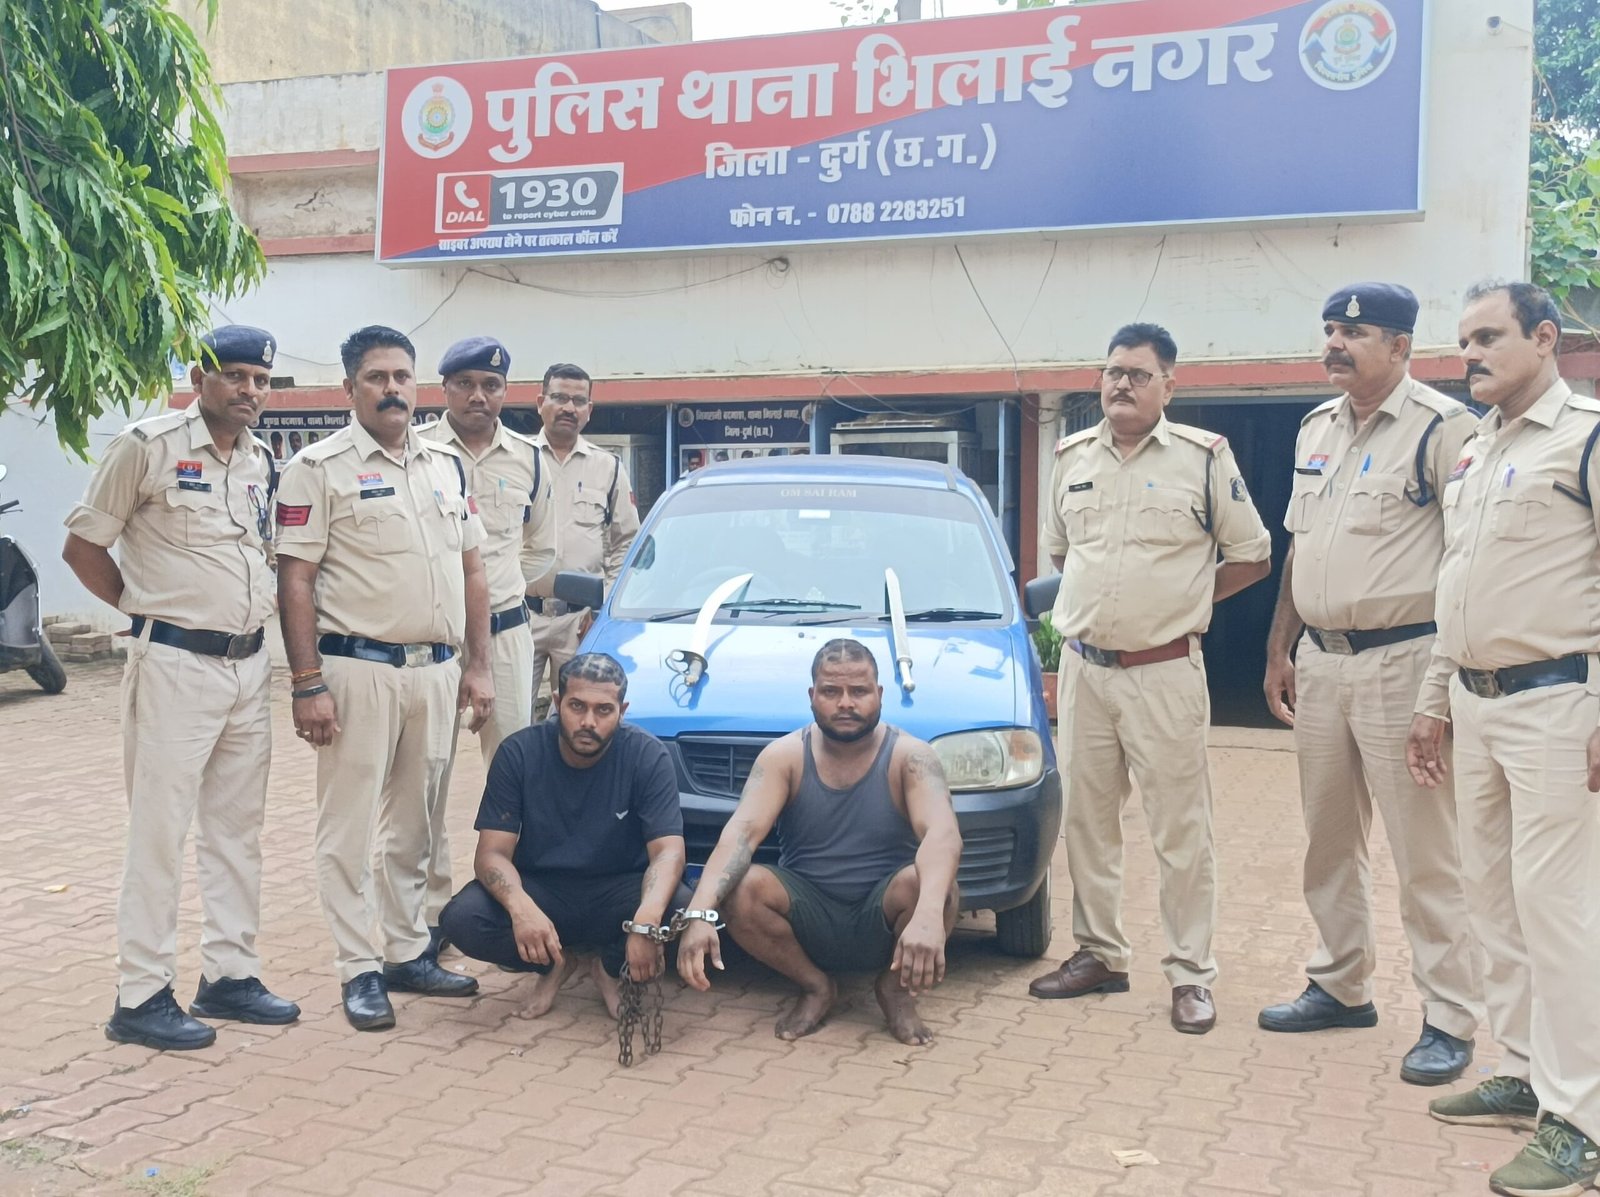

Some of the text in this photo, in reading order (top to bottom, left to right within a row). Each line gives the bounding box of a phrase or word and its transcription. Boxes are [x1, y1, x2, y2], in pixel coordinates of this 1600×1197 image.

[485, 15, 1279, 163] पुलिस थाना भिलाई नगर
[705, 142, 791, 179] जिला
[819, 130, 871, 183] दुर्ग
[876, 123, 997, 176] (छ.ग.)
[499, 177, 597, 209] 1930
[445, 211, 485, 224] DIAL
[502, 208, 597, 220] to report cyber crime
[729, 203, 773, 228] फोन
[827, 202, 875, 224] 0788
[880, 196, 965, 222] 2283251
[504, 233, 522, 248] होने
[524, 234, 538, 247] पर
[575, 229, 600, 245] कॉल
[780, 488, 800, 497] OM
[829, 488, 857, 498] RAM
